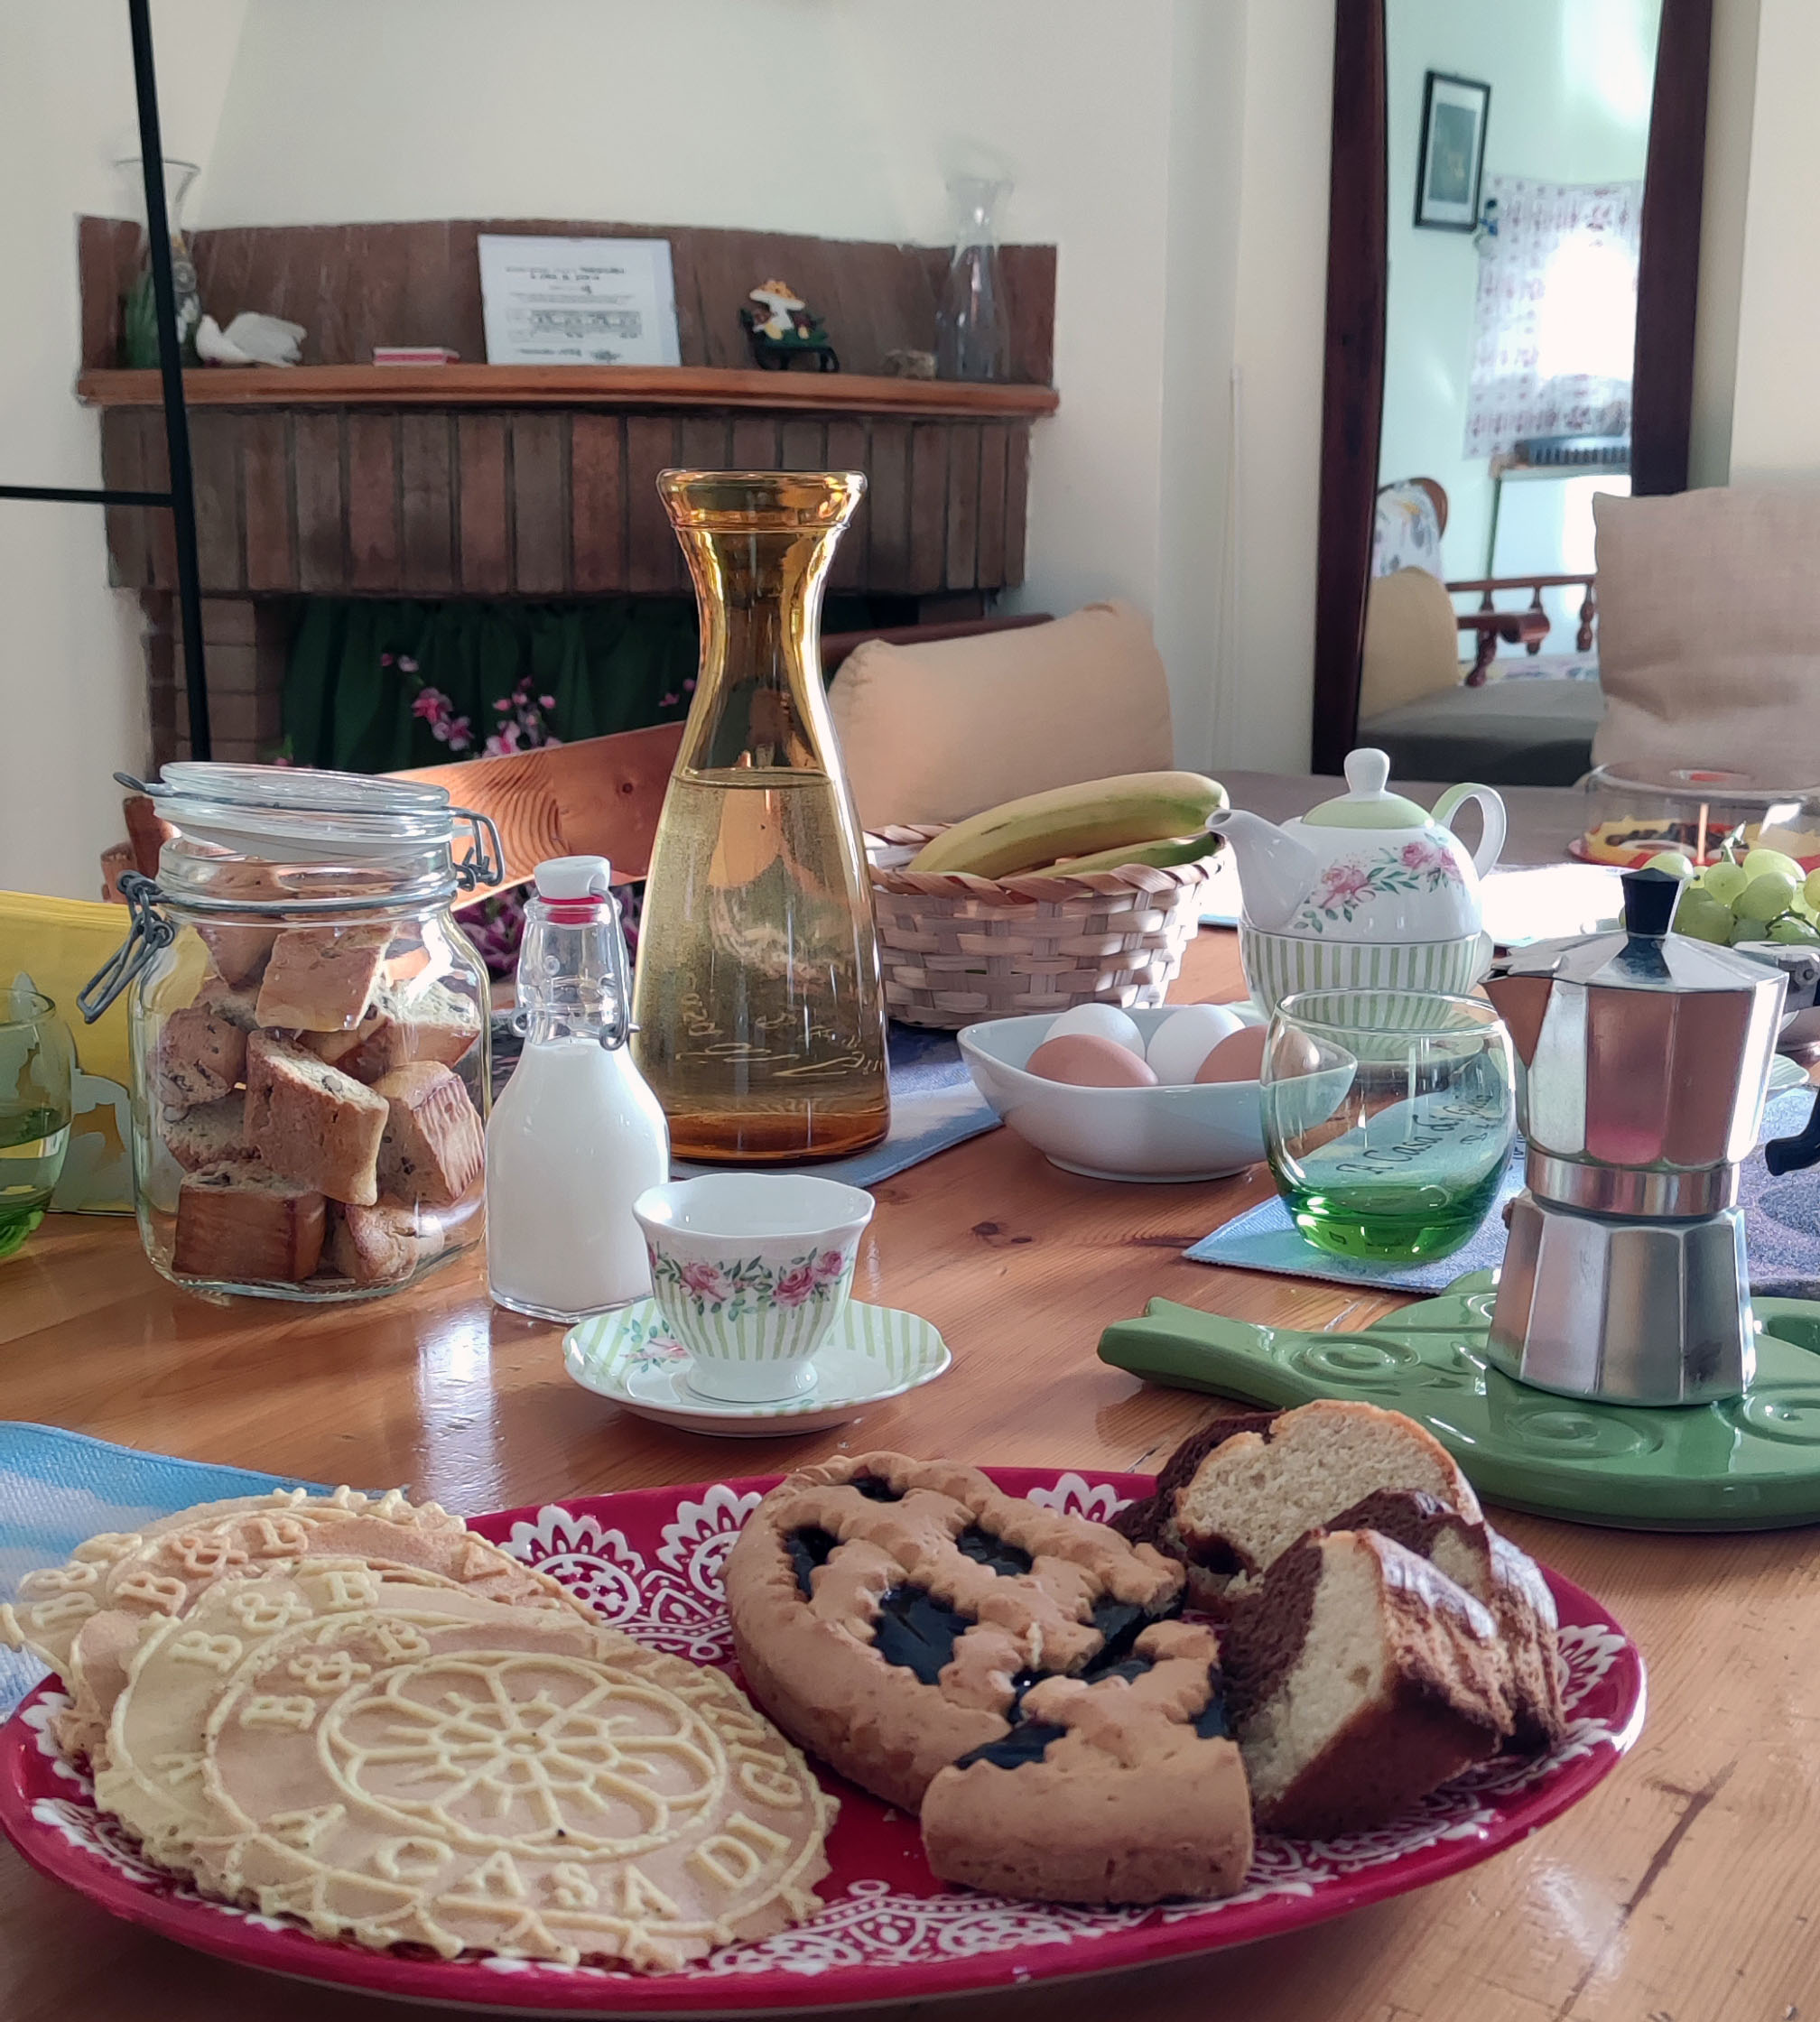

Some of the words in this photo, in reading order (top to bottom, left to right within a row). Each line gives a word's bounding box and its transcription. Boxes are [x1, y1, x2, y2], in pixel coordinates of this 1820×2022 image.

[1362, 1135, 1444, 1163] Casa
[1412, 1113, 1466, 1133] di
[238, 1621, 432, 1732] B&B
[269, 1804, 348, 1849] A
[374, 1834, 682, 1922] CASA
[687, 1811, 793, 1890] DI
